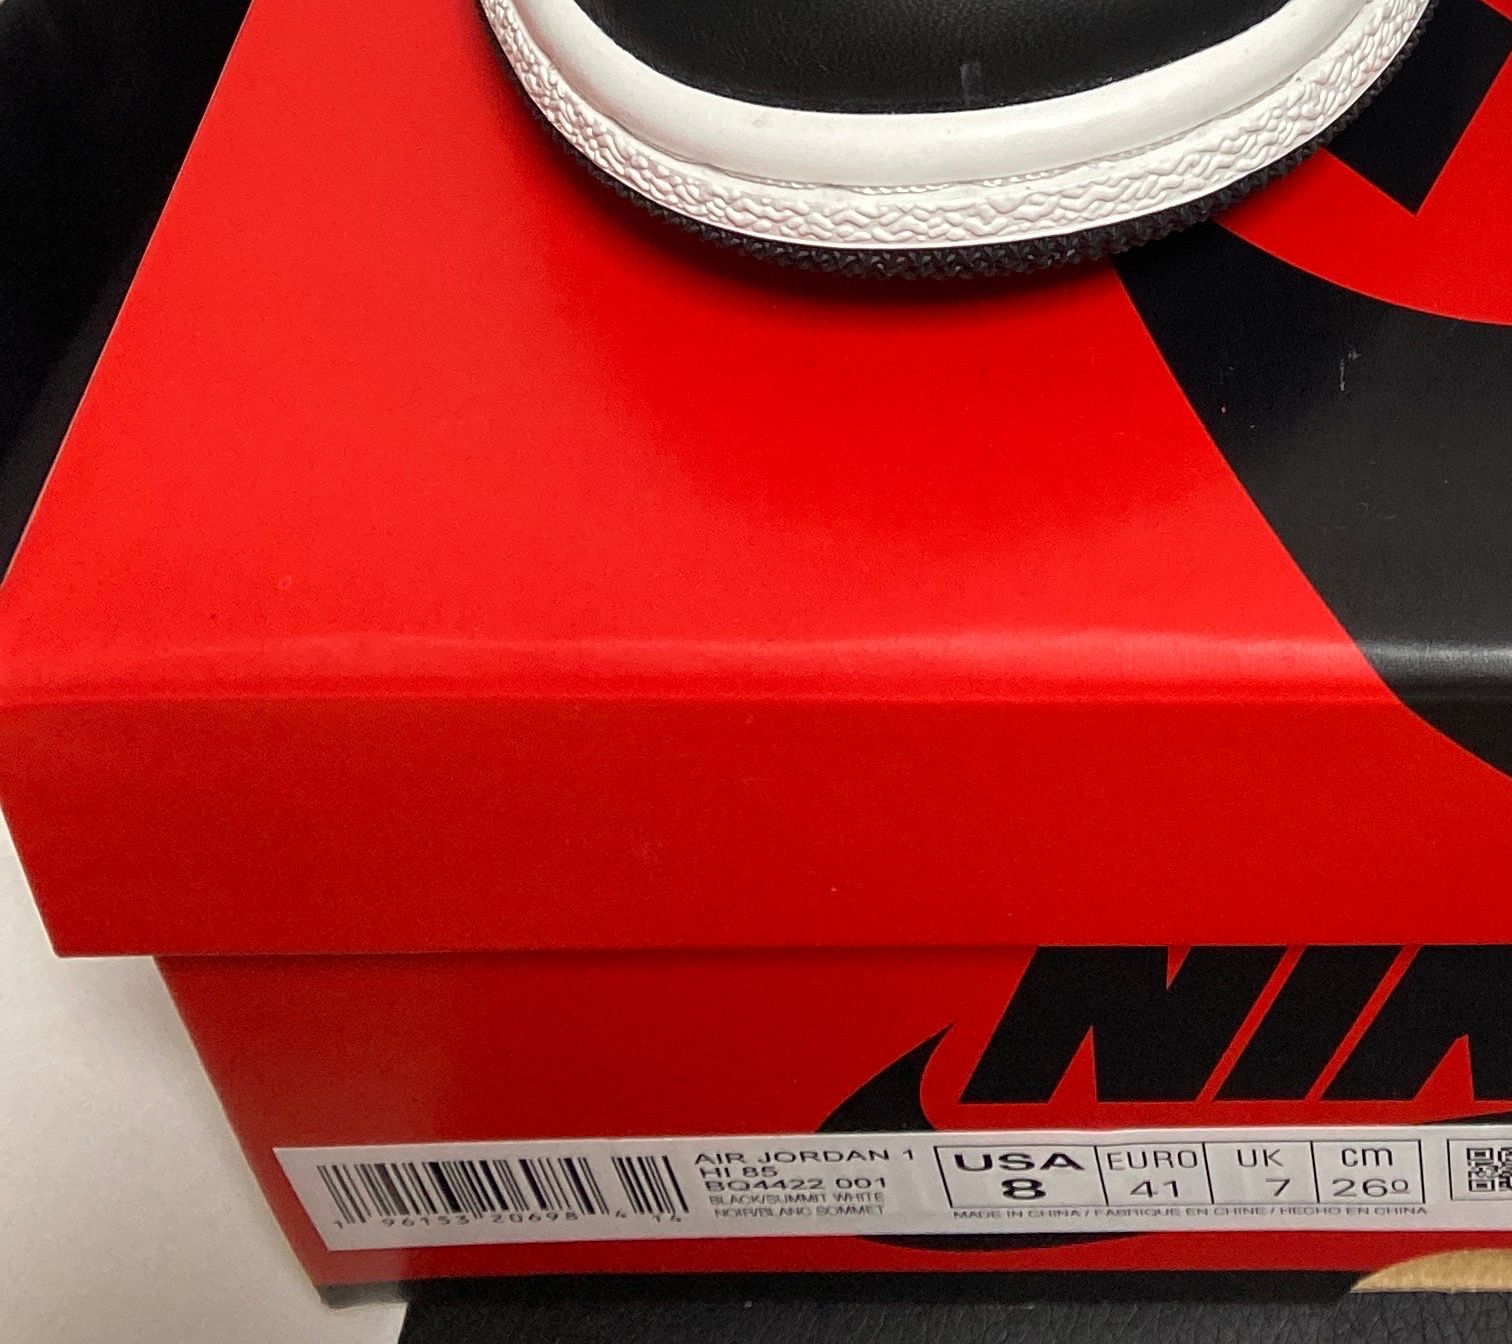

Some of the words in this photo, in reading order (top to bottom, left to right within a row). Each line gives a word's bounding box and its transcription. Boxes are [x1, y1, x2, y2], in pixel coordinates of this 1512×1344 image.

[695, 1152, 745, 1165] AIR
[758, 1150, 889, 1163] JORDAN
[903, 1149, 914, 1160] 1
[954, 1152, 1085, 1172] USA
[1107, 1149, 1198, 1170] EURO
[1236, 1148, 1284, 1168] UK
[1341, 1147, 1394, 1167] cm
[700, 1167, 731, 1179] HI
[743, 1166, 778, 1178] 85
[836, 1177, 886, 1189] 001
[1001, 1178, 1047, 1200] 8
[1130, 1179, 1179, 1199] 41
[1265, 1178, 1291, 1197] 7
